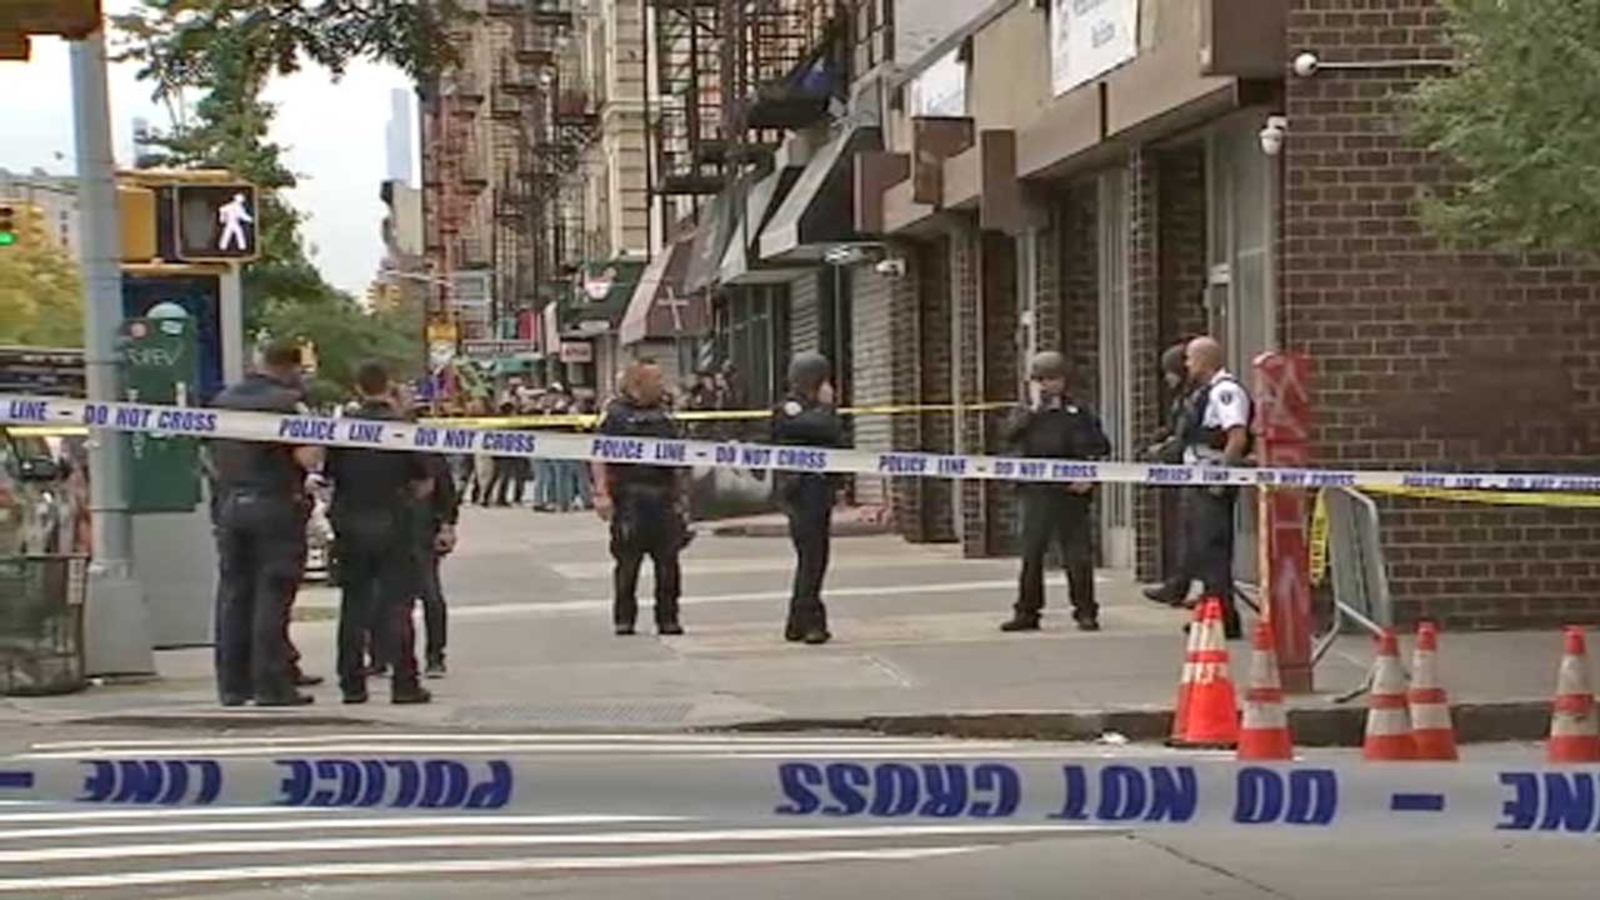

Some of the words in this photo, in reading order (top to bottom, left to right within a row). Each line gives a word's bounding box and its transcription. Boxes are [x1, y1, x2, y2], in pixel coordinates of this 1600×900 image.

[9, 401, 46, 420] LINE
[84, 405, 108, 424] DO
[116, 407, 151, 427] NOT
[158, 411, 217, 431] CROSS
[279, 419, 335, 440] POLICE
[349, 422, 384, 442] LINE
[414, 427, 438, 446] DO
[443, 429, 476, 449] NOT
[482, 432, 535, 452] CROSS
[591, 440, 643, 459] POLICE
[655, 443, 686, 461] LINE
[716, 446, 736, 463] DO
[741, 449, 770, 465] NOT
[777, 450, 827, 467] CROSS
[879, 455, 927, 472] POLICE
[938, 458, 967, 474] LINE
[994, 461, 1014, 475] DO
[1020, 462, 1047, 477] NOT
[1053, 464, 1097, 478] CROSS
[75, 760, 222, 802] LINE
[270, 760, 513, 808] POLICE
[775, 763, 1021, 818] CROSS
[1045, 765, 1197, 823] NOT
[1233, 767, 1338, 824] DO
[1391, 794, 1444, 811] -
[1494, 771, 1600, 832] NE
